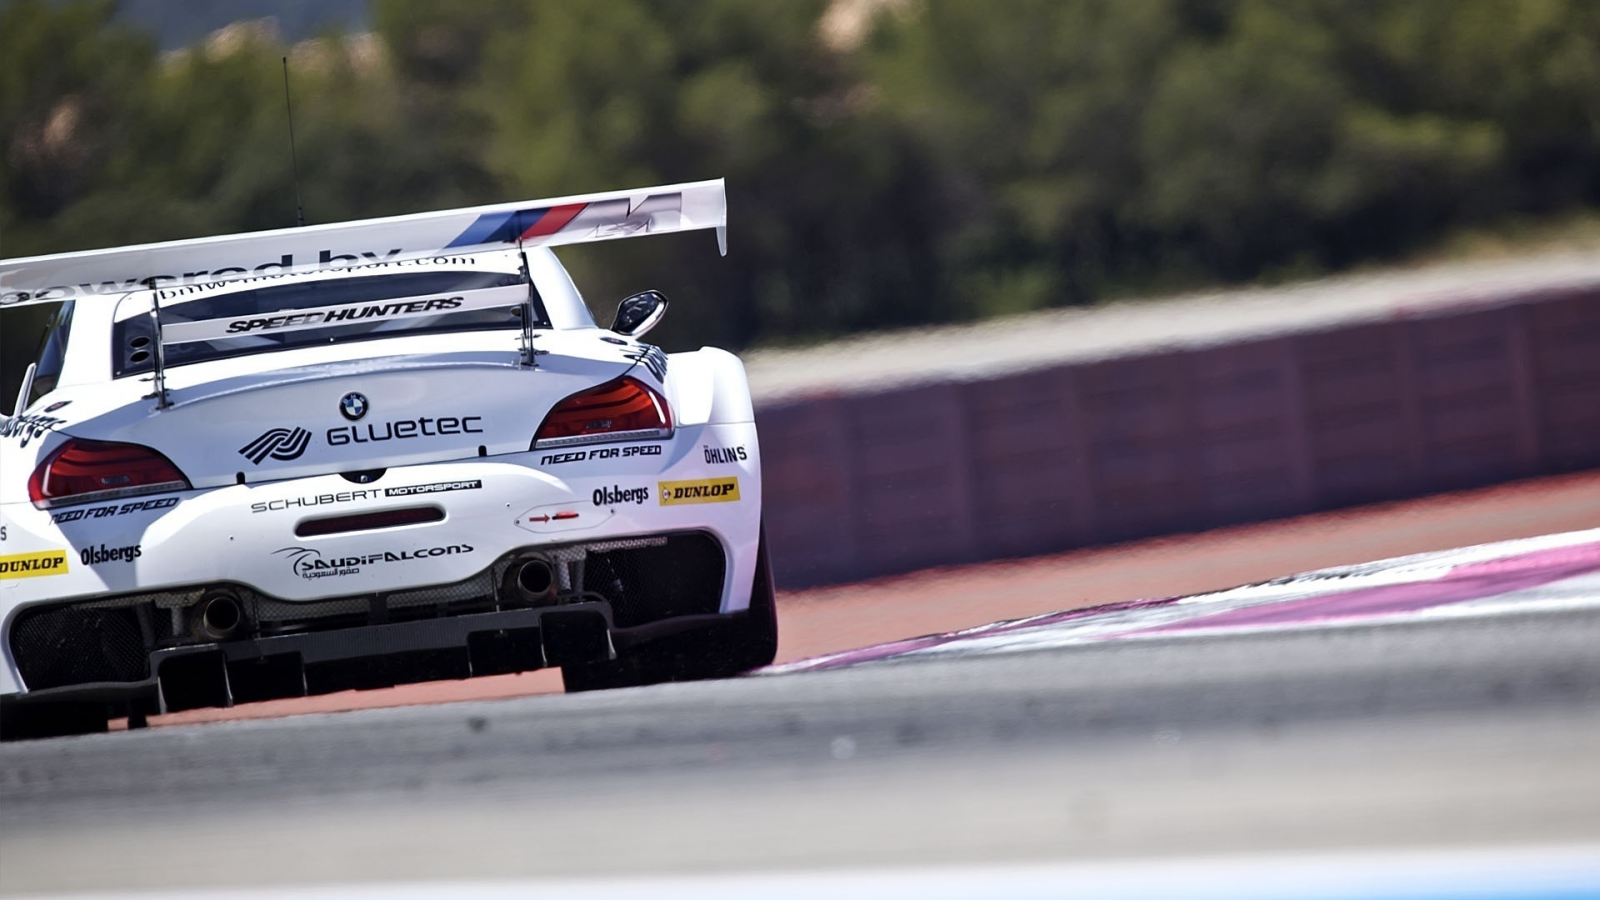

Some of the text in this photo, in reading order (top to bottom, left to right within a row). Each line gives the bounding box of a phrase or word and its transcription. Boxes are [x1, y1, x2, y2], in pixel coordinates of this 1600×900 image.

[226, 297, 464, 334] SPEEDHUNTERS
[541, 445, 662, 466] NEED FOR SPEED
[704, 445, 748, 464] ÖHLINS
[251, 480, 478, 513] SCHUBERT MOTORSPORT
[593, 485, 649, 506] Olsbergs
[673, 483, 735, 499] DUNLOP
[49, 497, 180, 526] NEED FOR SPEED
[0, 557, 64, 573] DUNLOP
[81, 544, 142, 566] Olsbergs
